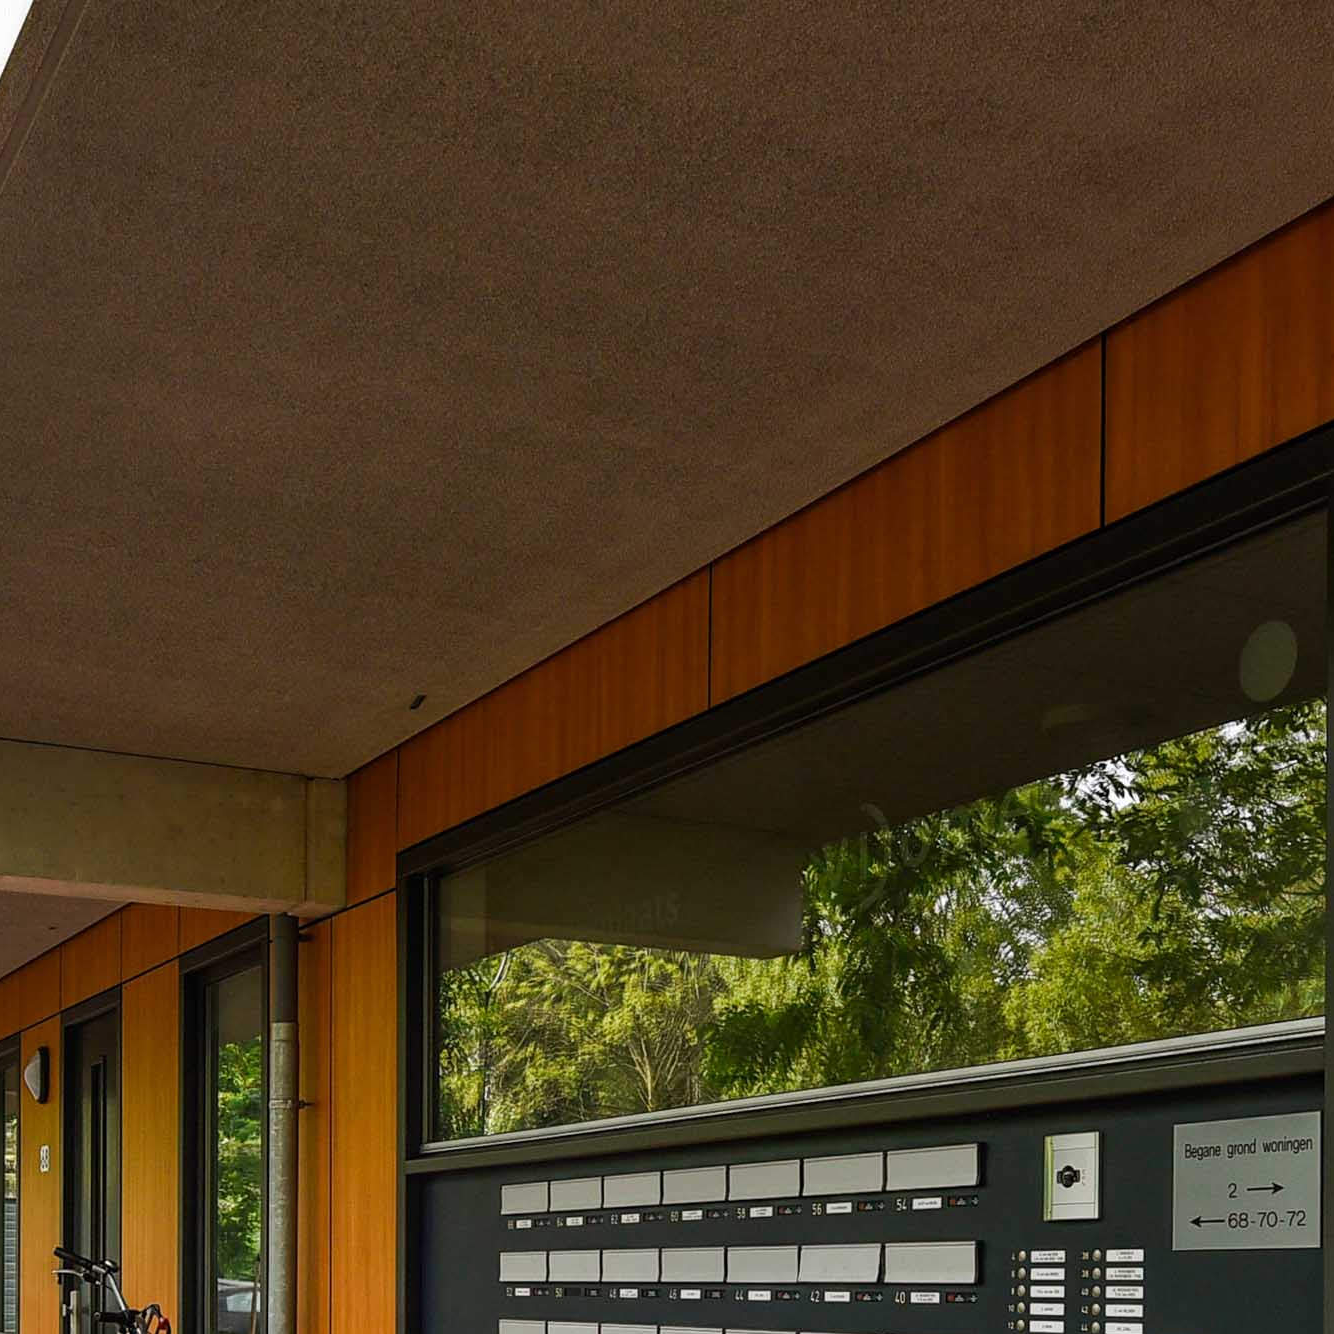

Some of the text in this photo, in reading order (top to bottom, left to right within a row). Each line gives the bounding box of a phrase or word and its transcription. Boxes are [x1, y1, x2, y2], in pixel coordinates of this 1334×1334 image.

[1184, 1136, 1313, 1161] Begane grond woningen
[1228, 1182, 1238, 1199] 2
[896, 1198, 907, 1212] 54
[1227, 1210, 1307, 1229] 68-70-72
[894, 1291, 906, 1305] 40
